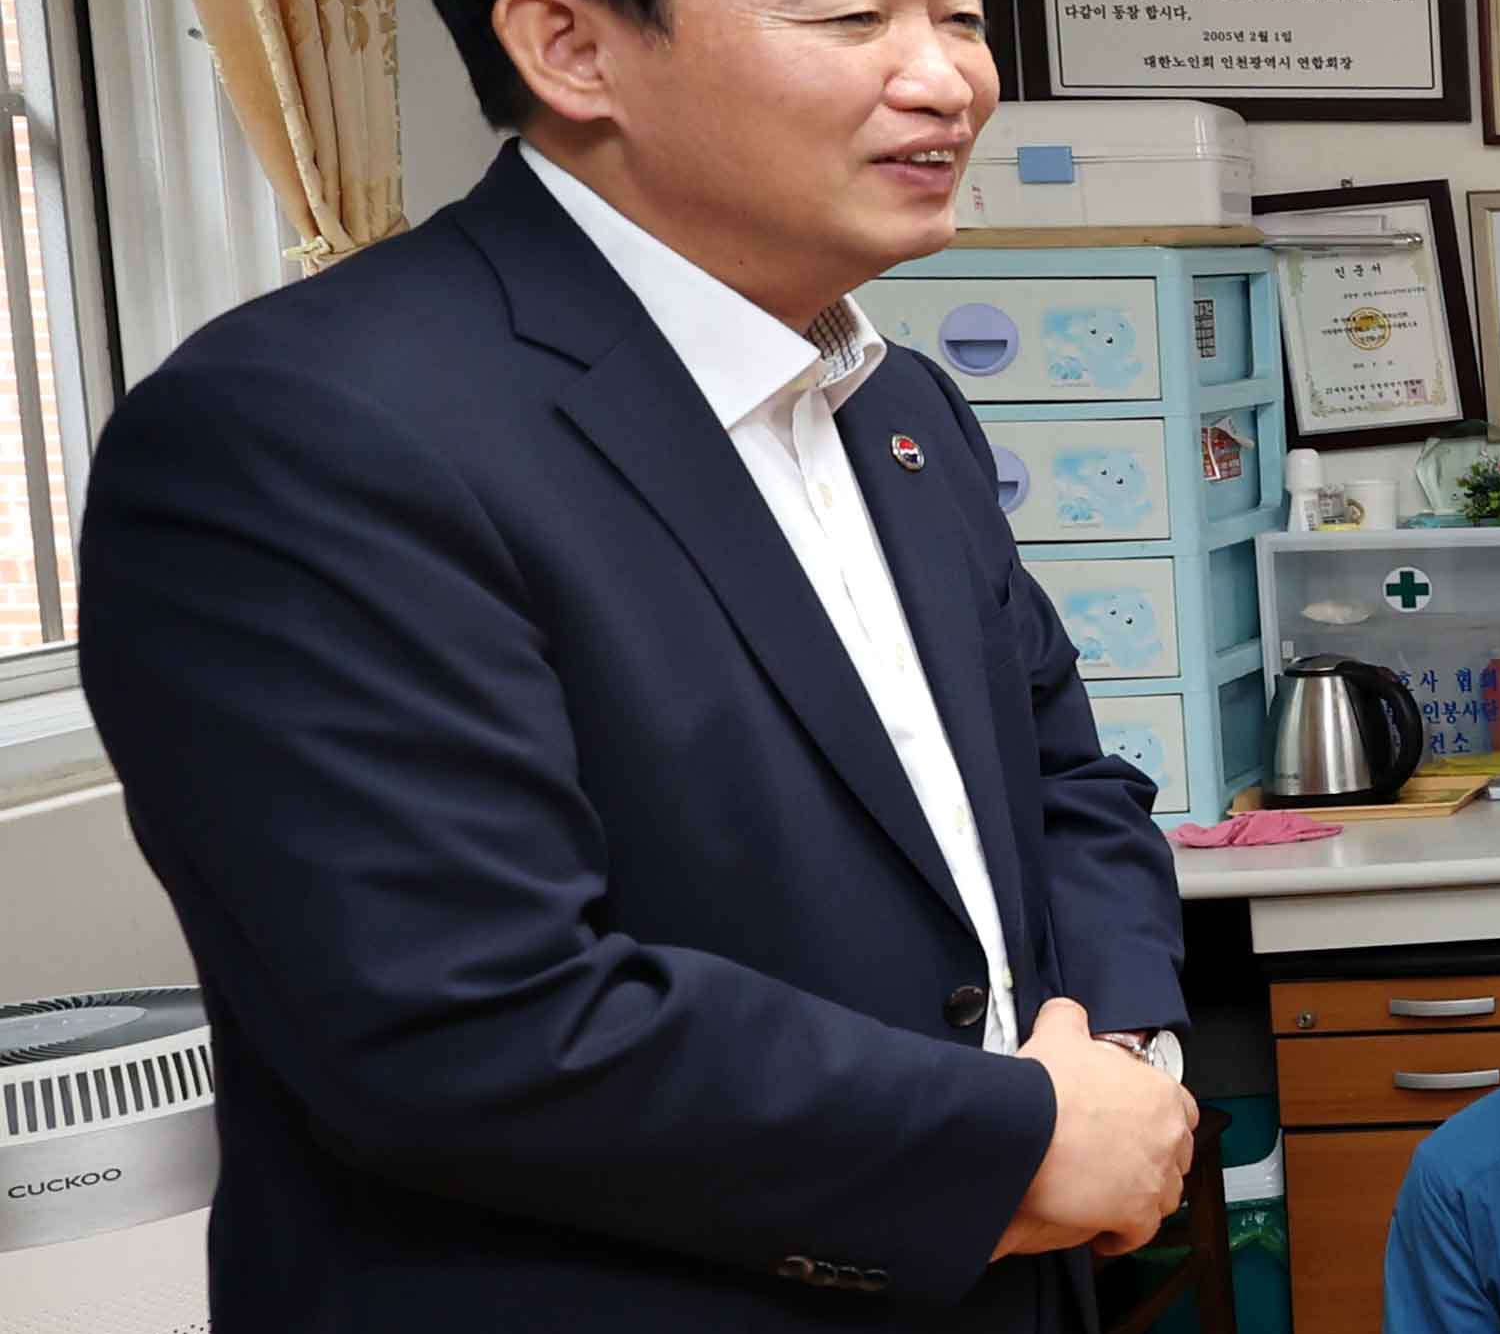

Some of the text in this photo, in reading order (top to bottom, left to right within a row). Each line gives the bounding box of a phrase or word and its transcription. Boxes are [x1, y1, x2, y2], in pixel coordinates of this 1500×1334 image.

[1143, 54, 1215, 69] 대한노인회
[1220, 55, 1291, 70] 인천광역시
[8, 1168, 122, 1199] CUCKOO
